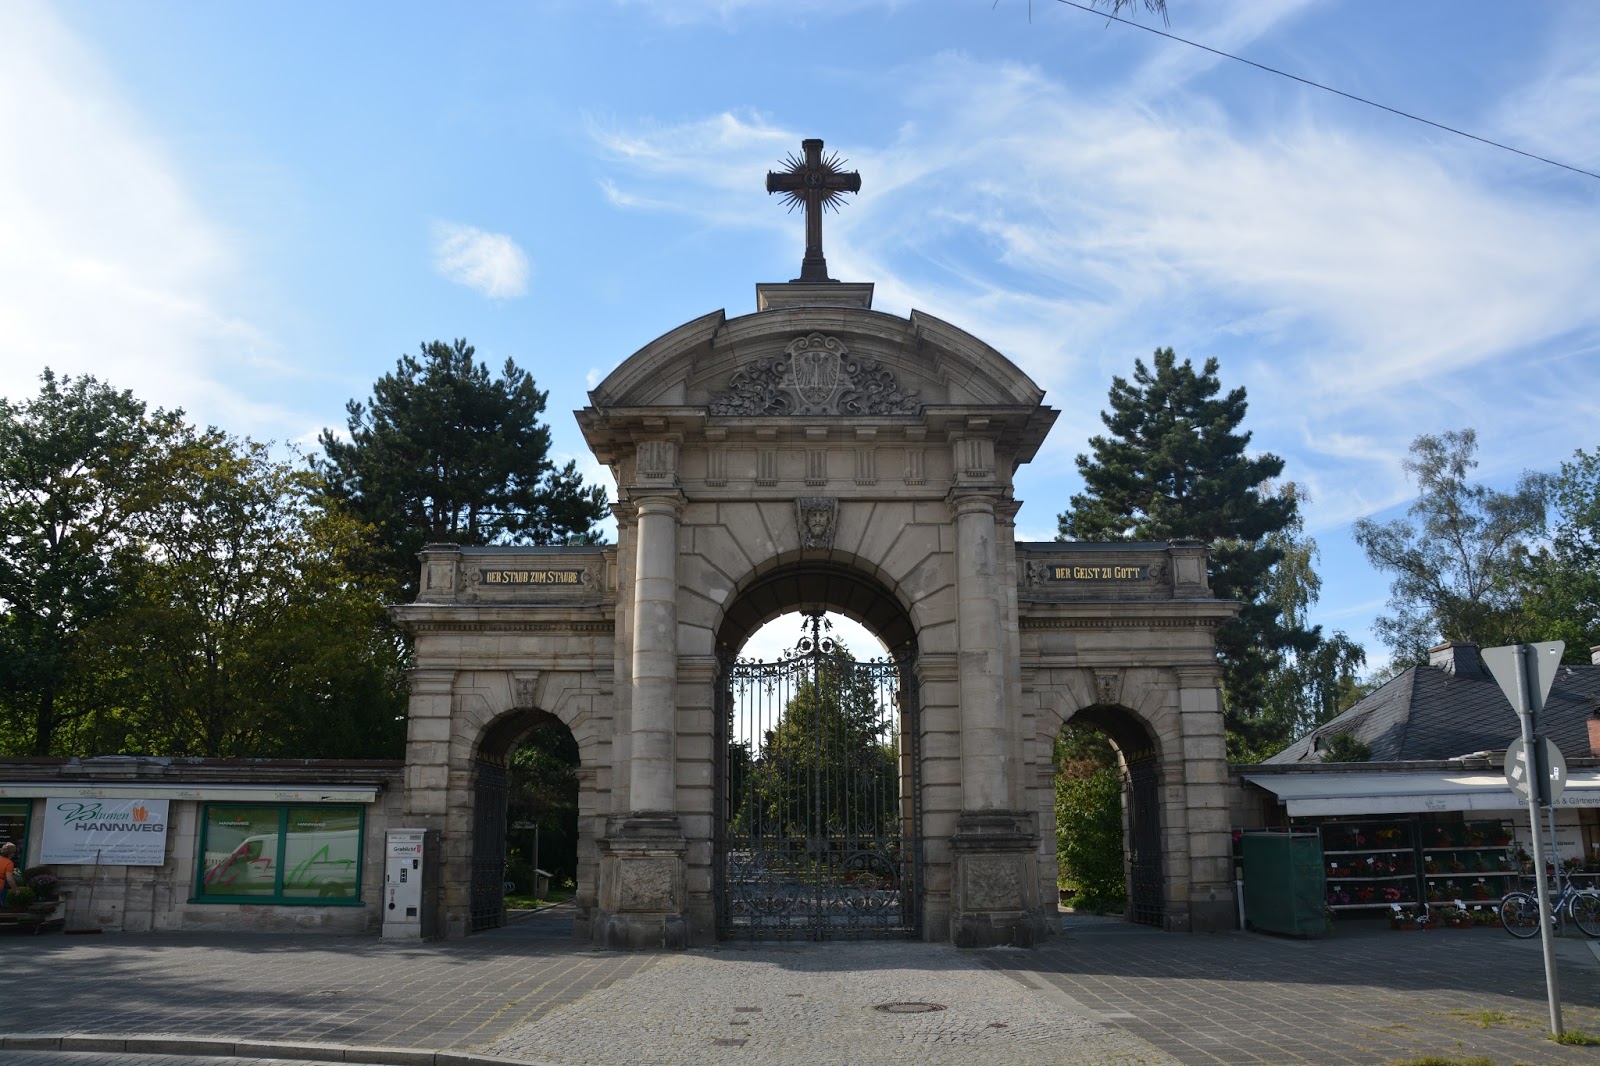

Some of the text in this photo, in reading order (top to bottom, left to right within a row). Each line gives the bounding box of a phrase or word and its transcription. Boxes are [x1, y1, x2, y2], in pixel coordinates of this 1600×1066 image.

[487, 571, 578, 583] DER STAUB ZUM STAUBE
[1055, 566, 1140, 579] DER GEIST ZU GOTT
[57, 802, 130, 826] Blumen
[75, 822, 164, 833] HANNWEG
